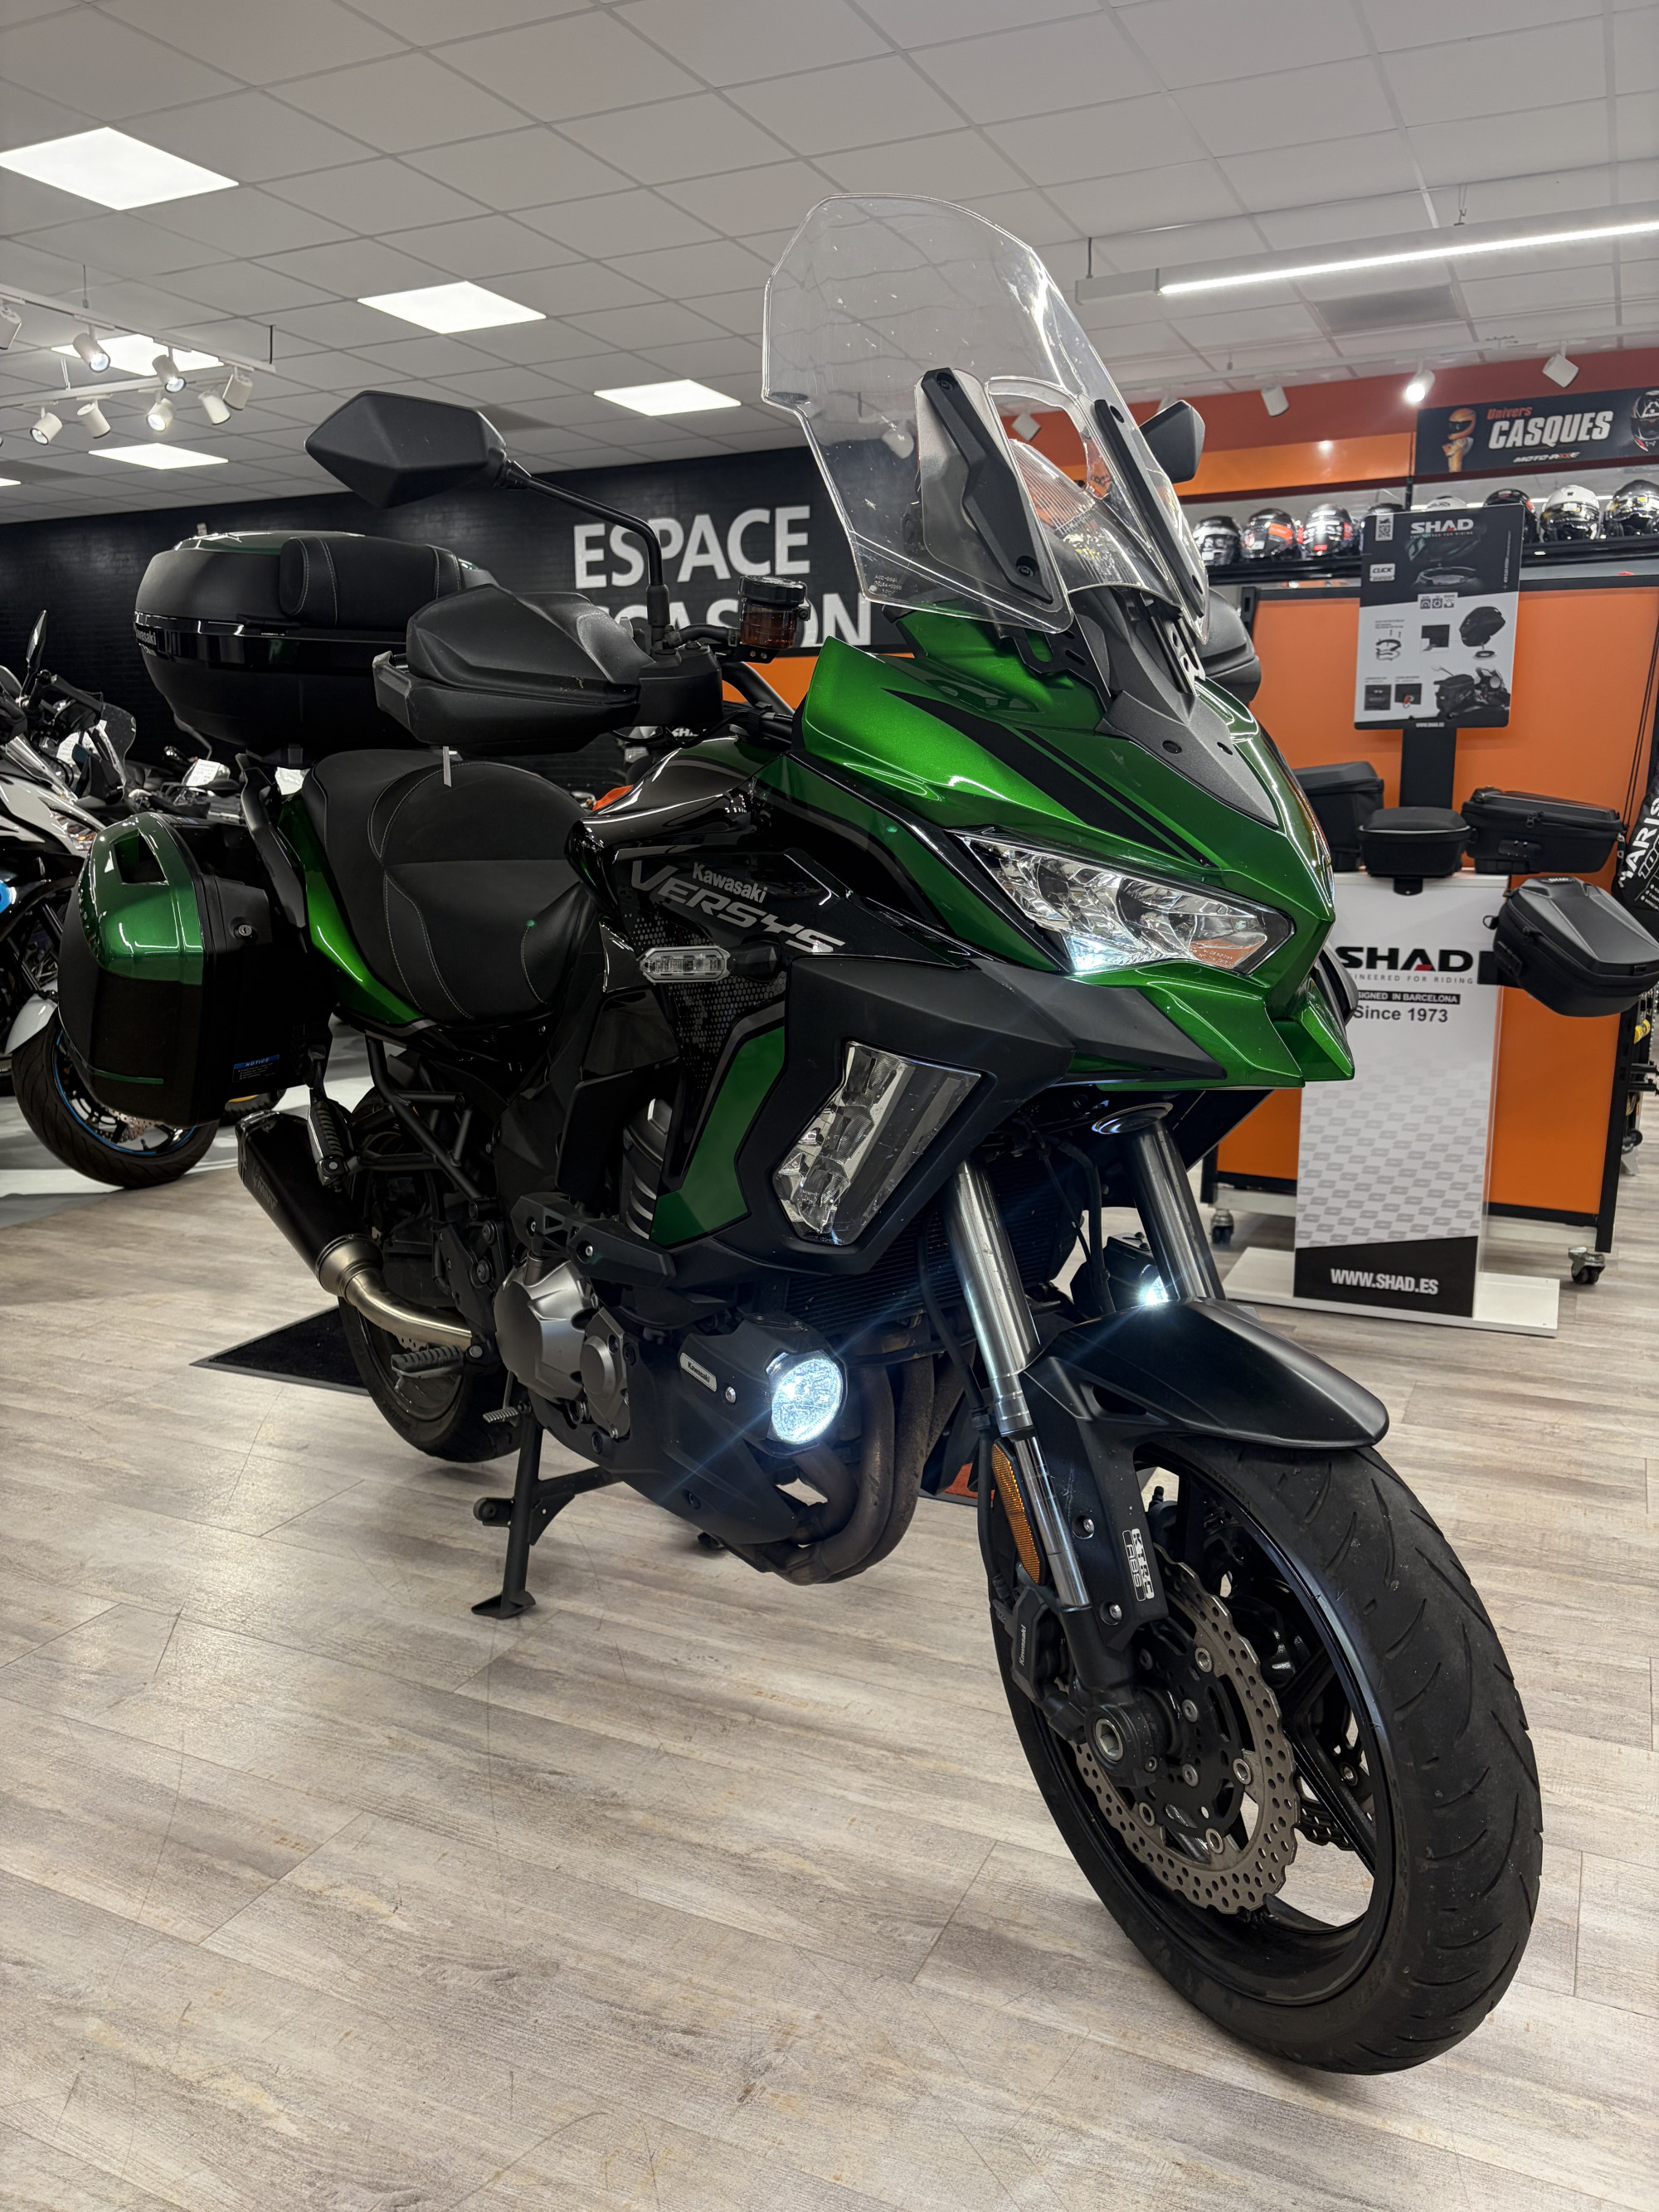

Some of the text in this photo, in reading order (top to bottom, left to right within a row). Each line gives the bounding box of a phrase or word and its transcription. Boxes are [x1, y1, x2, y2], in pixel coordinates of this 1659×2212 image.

[1486, 406, 1532, 420] Univers
[1488, 411, 1614, 450] CASQUES
[1410, 518, 1474, 535] SHAD
[573, 505, 810, 590] ESPACE
[692, 862, 768, 903] Kawasaki
[630, 860, 846, 954] VERSYS
[1335, 946, 1474, 972] SHAD
[1434, 976, 1473, 984] RIDING
[1358, 991, 1458, 1004] SIGNED IN BARCELONA
[1354, 1005, 1448, 1023] Since 1973
[1330, 1267, 1439, 1296] WWW.SHAD.ES
[688, 1361, 710, 1383] Kawasaki
[1133, 1533, 1154, 1594] KTRC
[1019, 1624, 1027, 1666] Kawasaki
